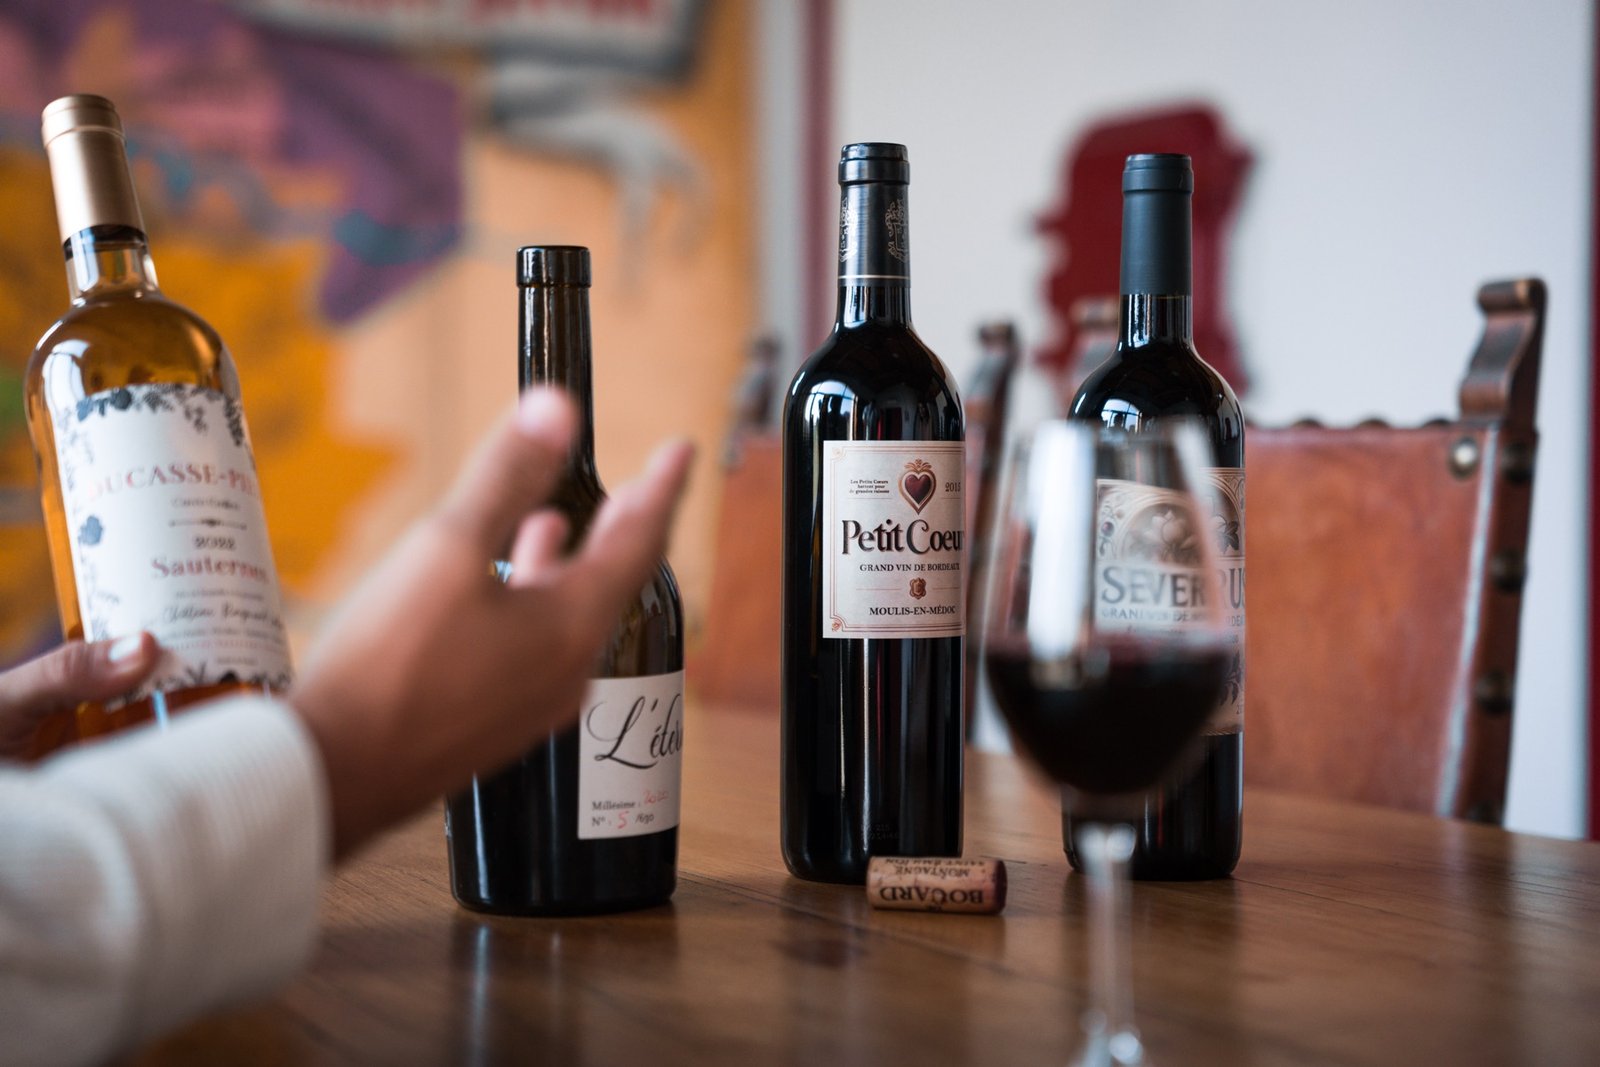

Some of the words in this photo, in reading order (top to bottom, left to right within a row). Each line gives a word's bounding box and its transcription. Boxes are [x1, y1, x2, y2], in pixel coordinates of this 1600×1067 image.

[841, 519, 904, 554] Petit
[860, 563, 894, 572] GRAND
[896, 563, 912, 571] VIN
[914, 563, 926, 571] DE
[869, 604, 956, 616] MOULIS-EN-MÉDOC
